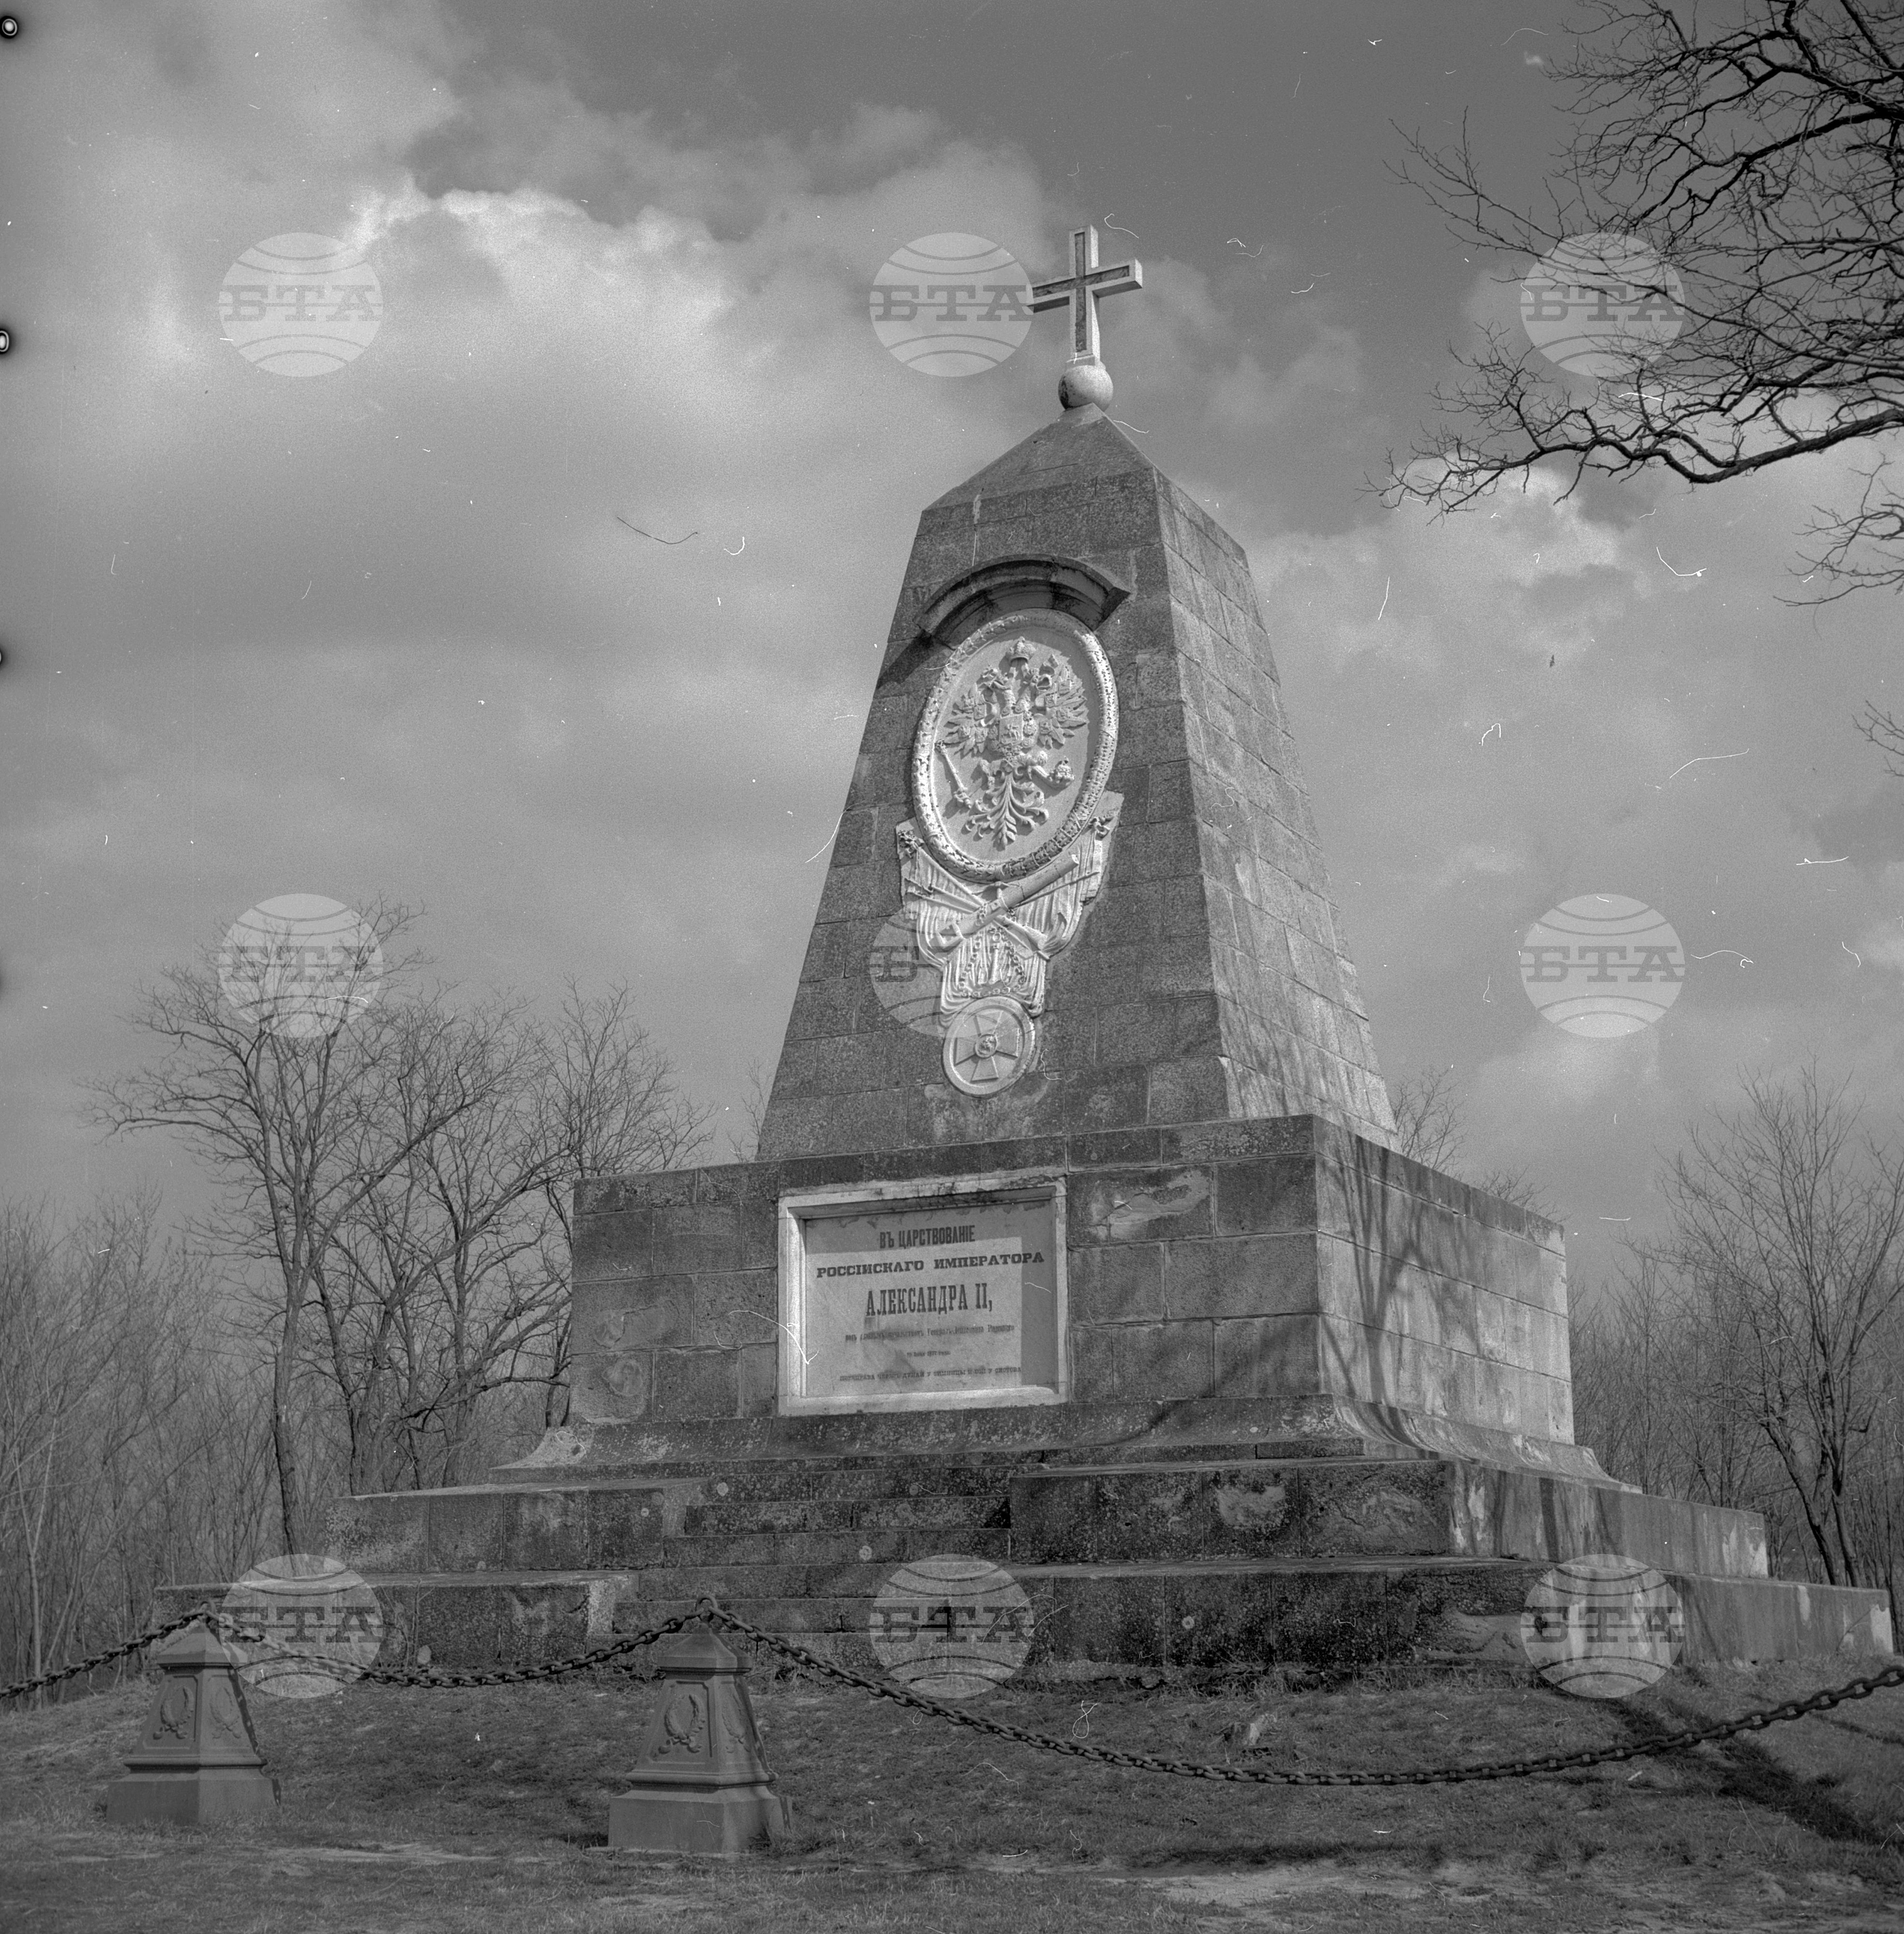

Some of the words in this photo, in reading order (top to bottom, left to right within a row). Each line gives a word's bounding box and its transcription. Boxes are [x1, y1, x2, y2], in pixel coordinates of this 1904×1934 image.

[880, 1231, 894, 1248] ВЪ
[934, 1252, 1045, 1269] ИМПЕРАТОРА
[866, 1284, 968, 1316] АЛЕКСАНДРА
